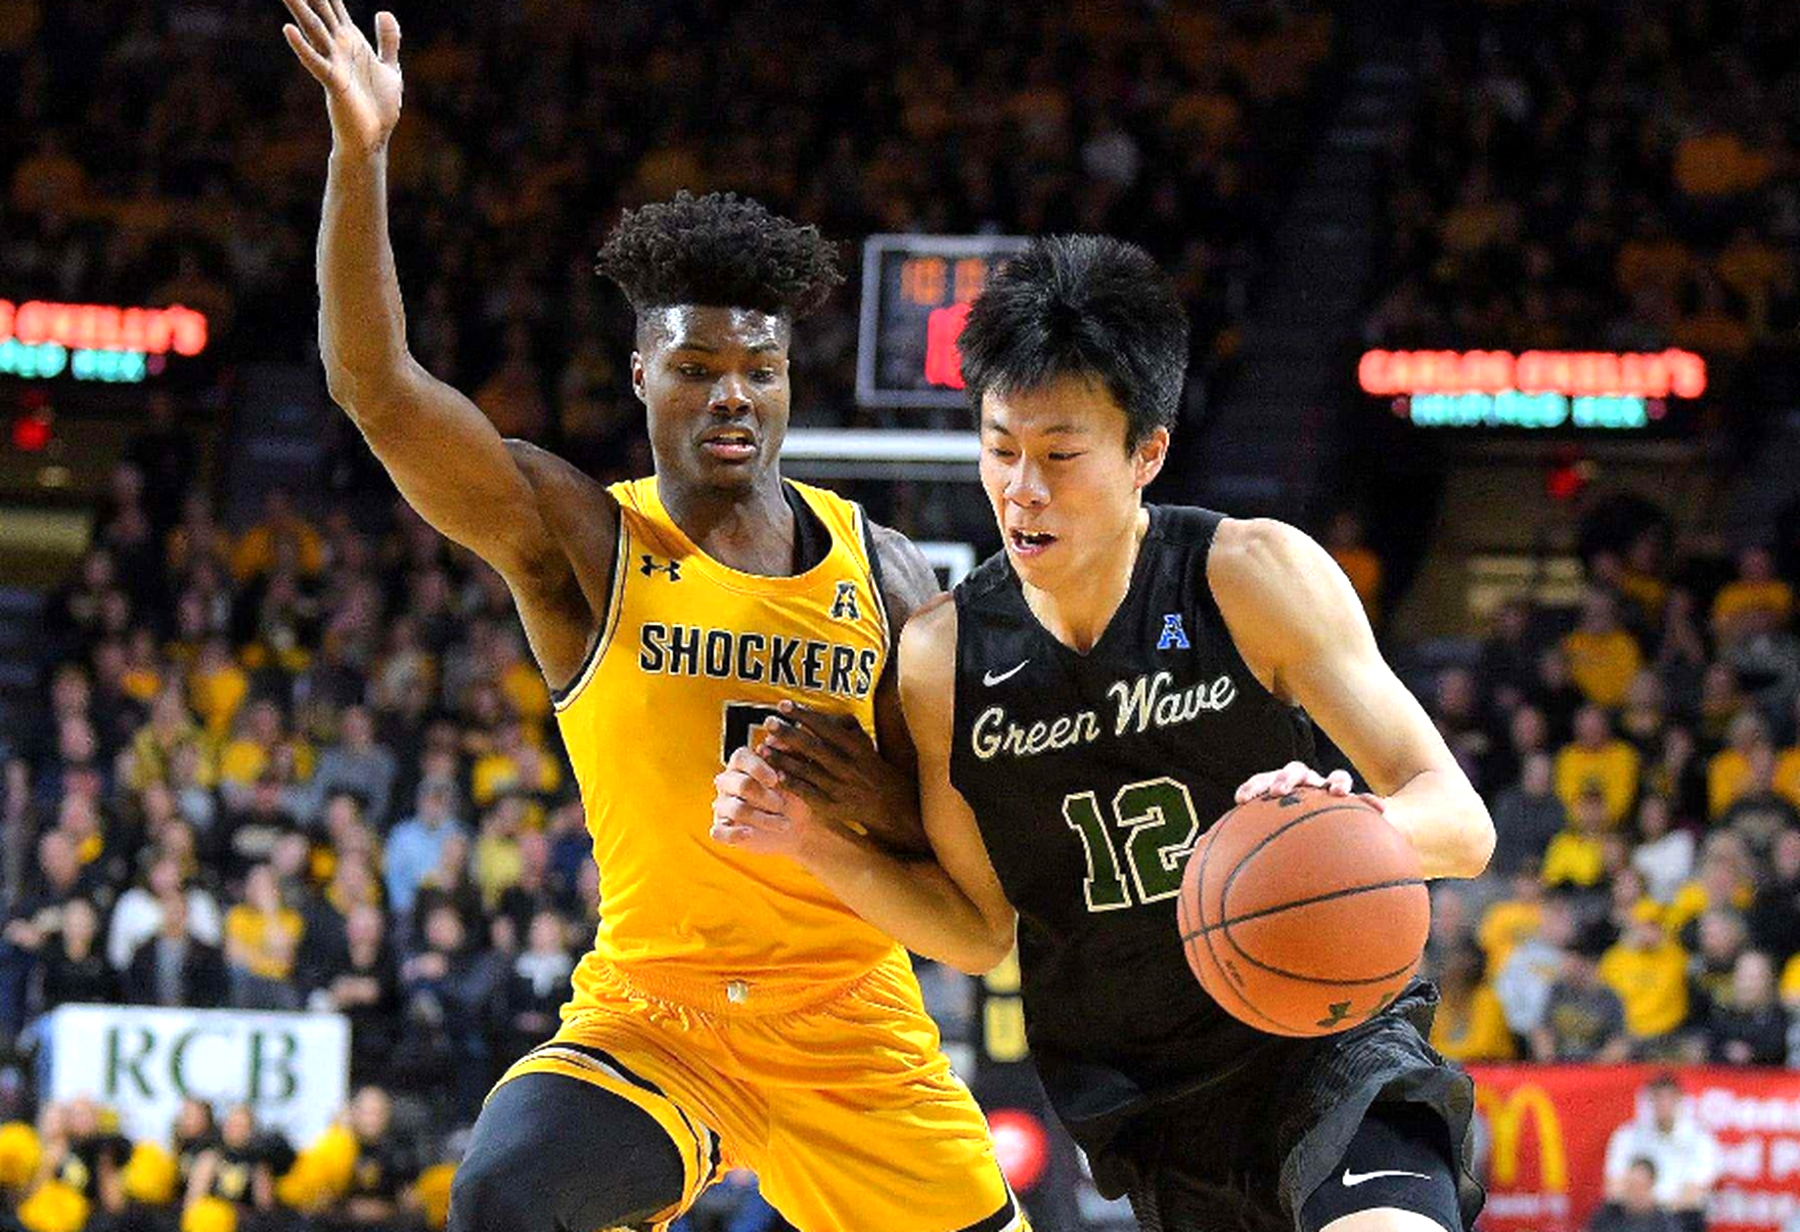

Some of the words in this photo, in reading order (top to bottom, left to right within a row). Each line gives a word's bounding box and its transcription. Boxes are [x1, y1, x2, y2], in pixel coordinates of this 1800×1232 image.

[830, 580, 861, 622] A
[1156, 613, 1191, 649] A
[638, 622, 877, 699] SHOCKERS
[971, 706, 1100, 759] Green
[1106, 671, 1237, 736] Wave
[1061, 776, 1199, 912] 12
[103, 1026, 298, 1102] RCB
